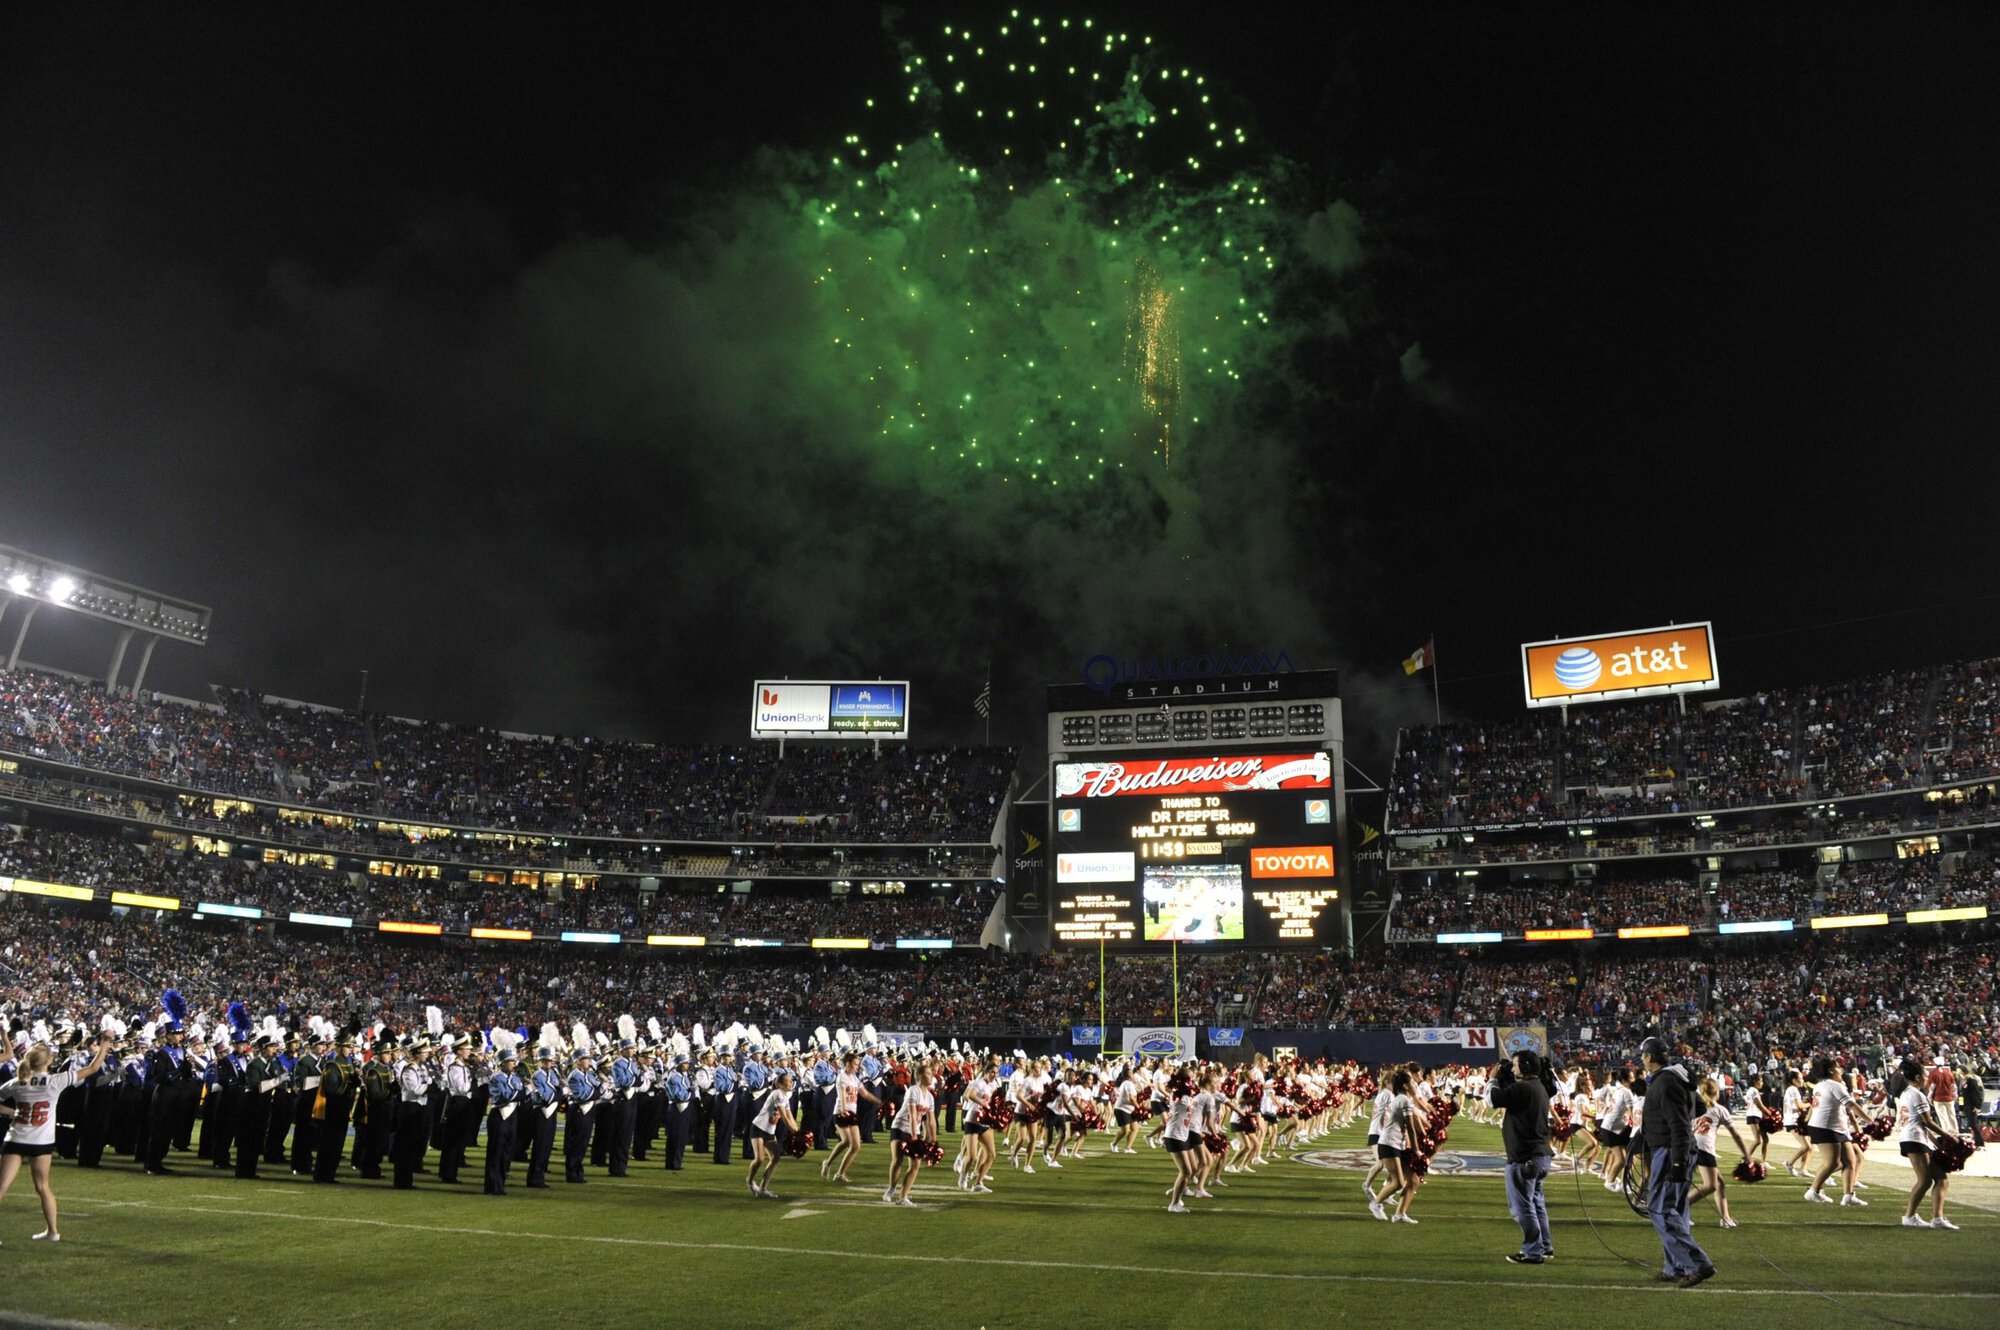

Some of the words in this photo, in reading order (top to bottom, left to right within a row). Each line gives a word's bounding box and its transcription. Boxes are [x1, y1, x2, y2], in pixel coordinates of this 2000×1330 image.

[1610, 641, 1689, 677] at&t
[1083, 651, 1296, 697] QUALCOMM
[1127, 680, 1279, 698] STADIUM
[761, 713, 825, 723] UnionBank
[833, 720, 856, 728] ready.
[1081, 757, 1263, 797] Budweiser
[1161, 797, 1202, 808] THANKS
[1205, 797, 1220, 807] TO
[1151, 811, 1171, 823] DR
[1176, 809, 1230, 822] PEPPER
[1131, 824, 1208, 838] HALFTIME
[1215, 822, 1256, 836] SHOW
[1142, 842, 1185, 858] 11:59
[1351, 850, 1385, 861] Sprint
[1014, 858, 1044, 870] Sprint
[1254, 854, 1330, 871] TOYOTA
[1139, 1032, 1164, 1044] PACIFIC
[1467, 1029, 1488, 1047] N
